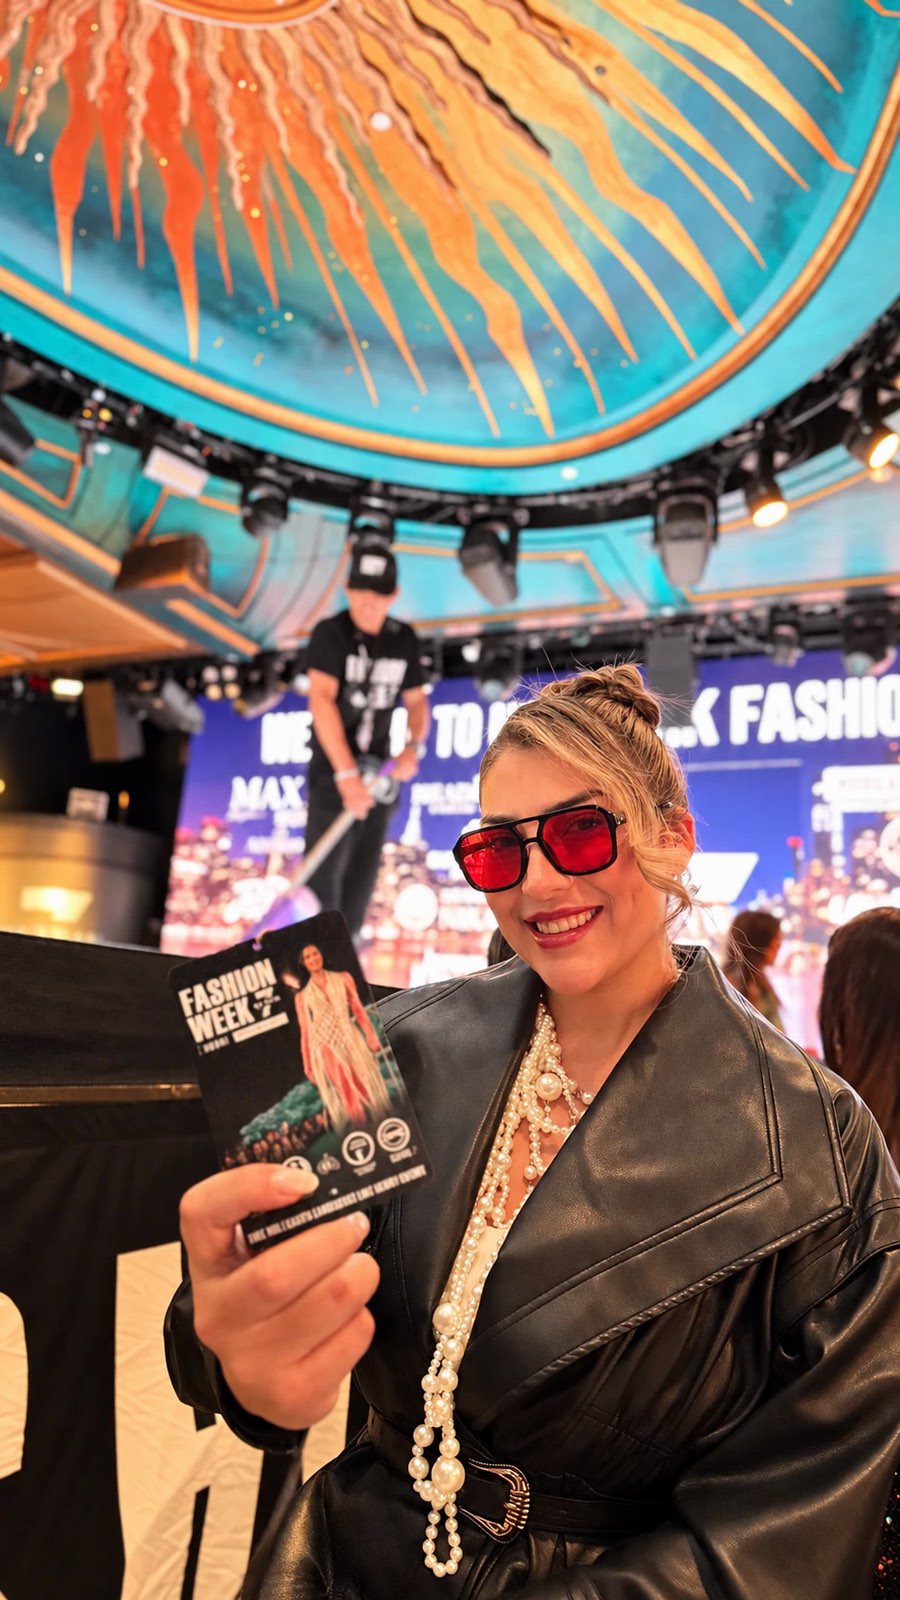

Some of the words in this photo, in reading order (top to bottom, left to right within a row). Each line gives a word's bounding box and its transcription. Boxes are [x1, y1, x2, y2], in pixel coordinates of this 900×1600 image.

[432, 702, 484, 759] TO
[178, 958, 277, 1018] FASHION
[187, 996, 256, 1043] WEEK
